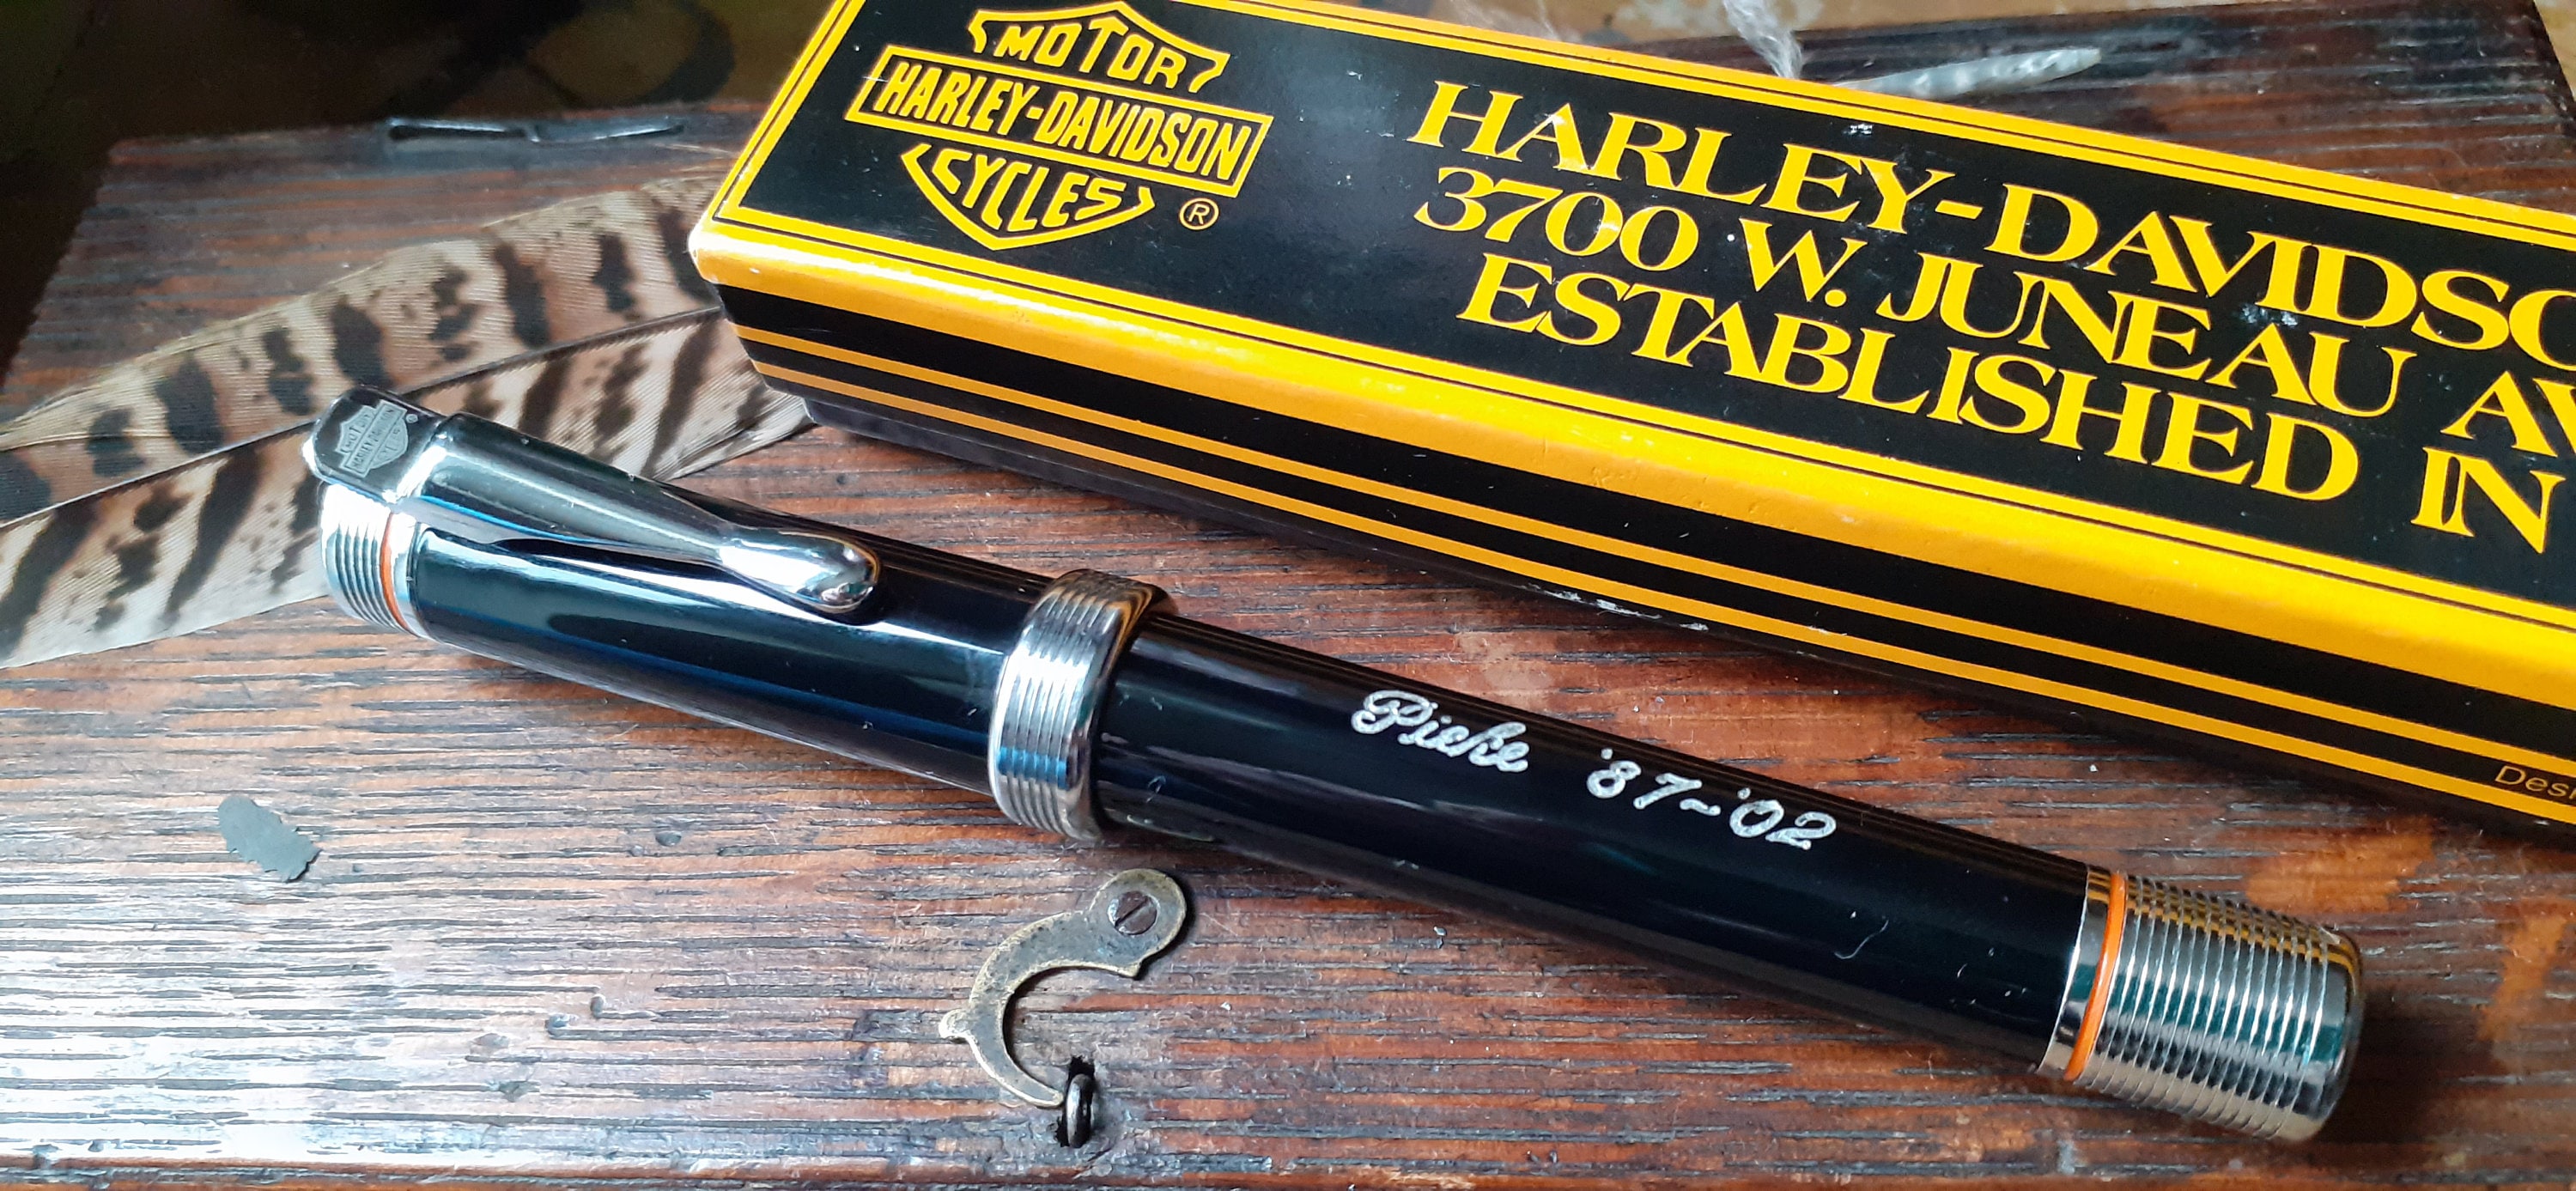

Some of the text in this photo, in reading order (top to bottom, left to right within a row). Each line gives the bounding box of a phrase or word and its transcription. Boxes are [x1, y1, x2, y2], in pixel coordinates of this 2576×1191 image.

[993, 15, 1188, 90] MOTOR
[872, 60, 1252, 180] HARLEY-DAVIDSON
[931, 147, 1127, 233] CYCLES
[1414, 166, 1699, 271] 3700
[1739, 217, 1868, 307] W.
[1875, 252, 2417, 419] JUNEAU
[1455, 252, 2567, 555] ESTABLISHED IN
